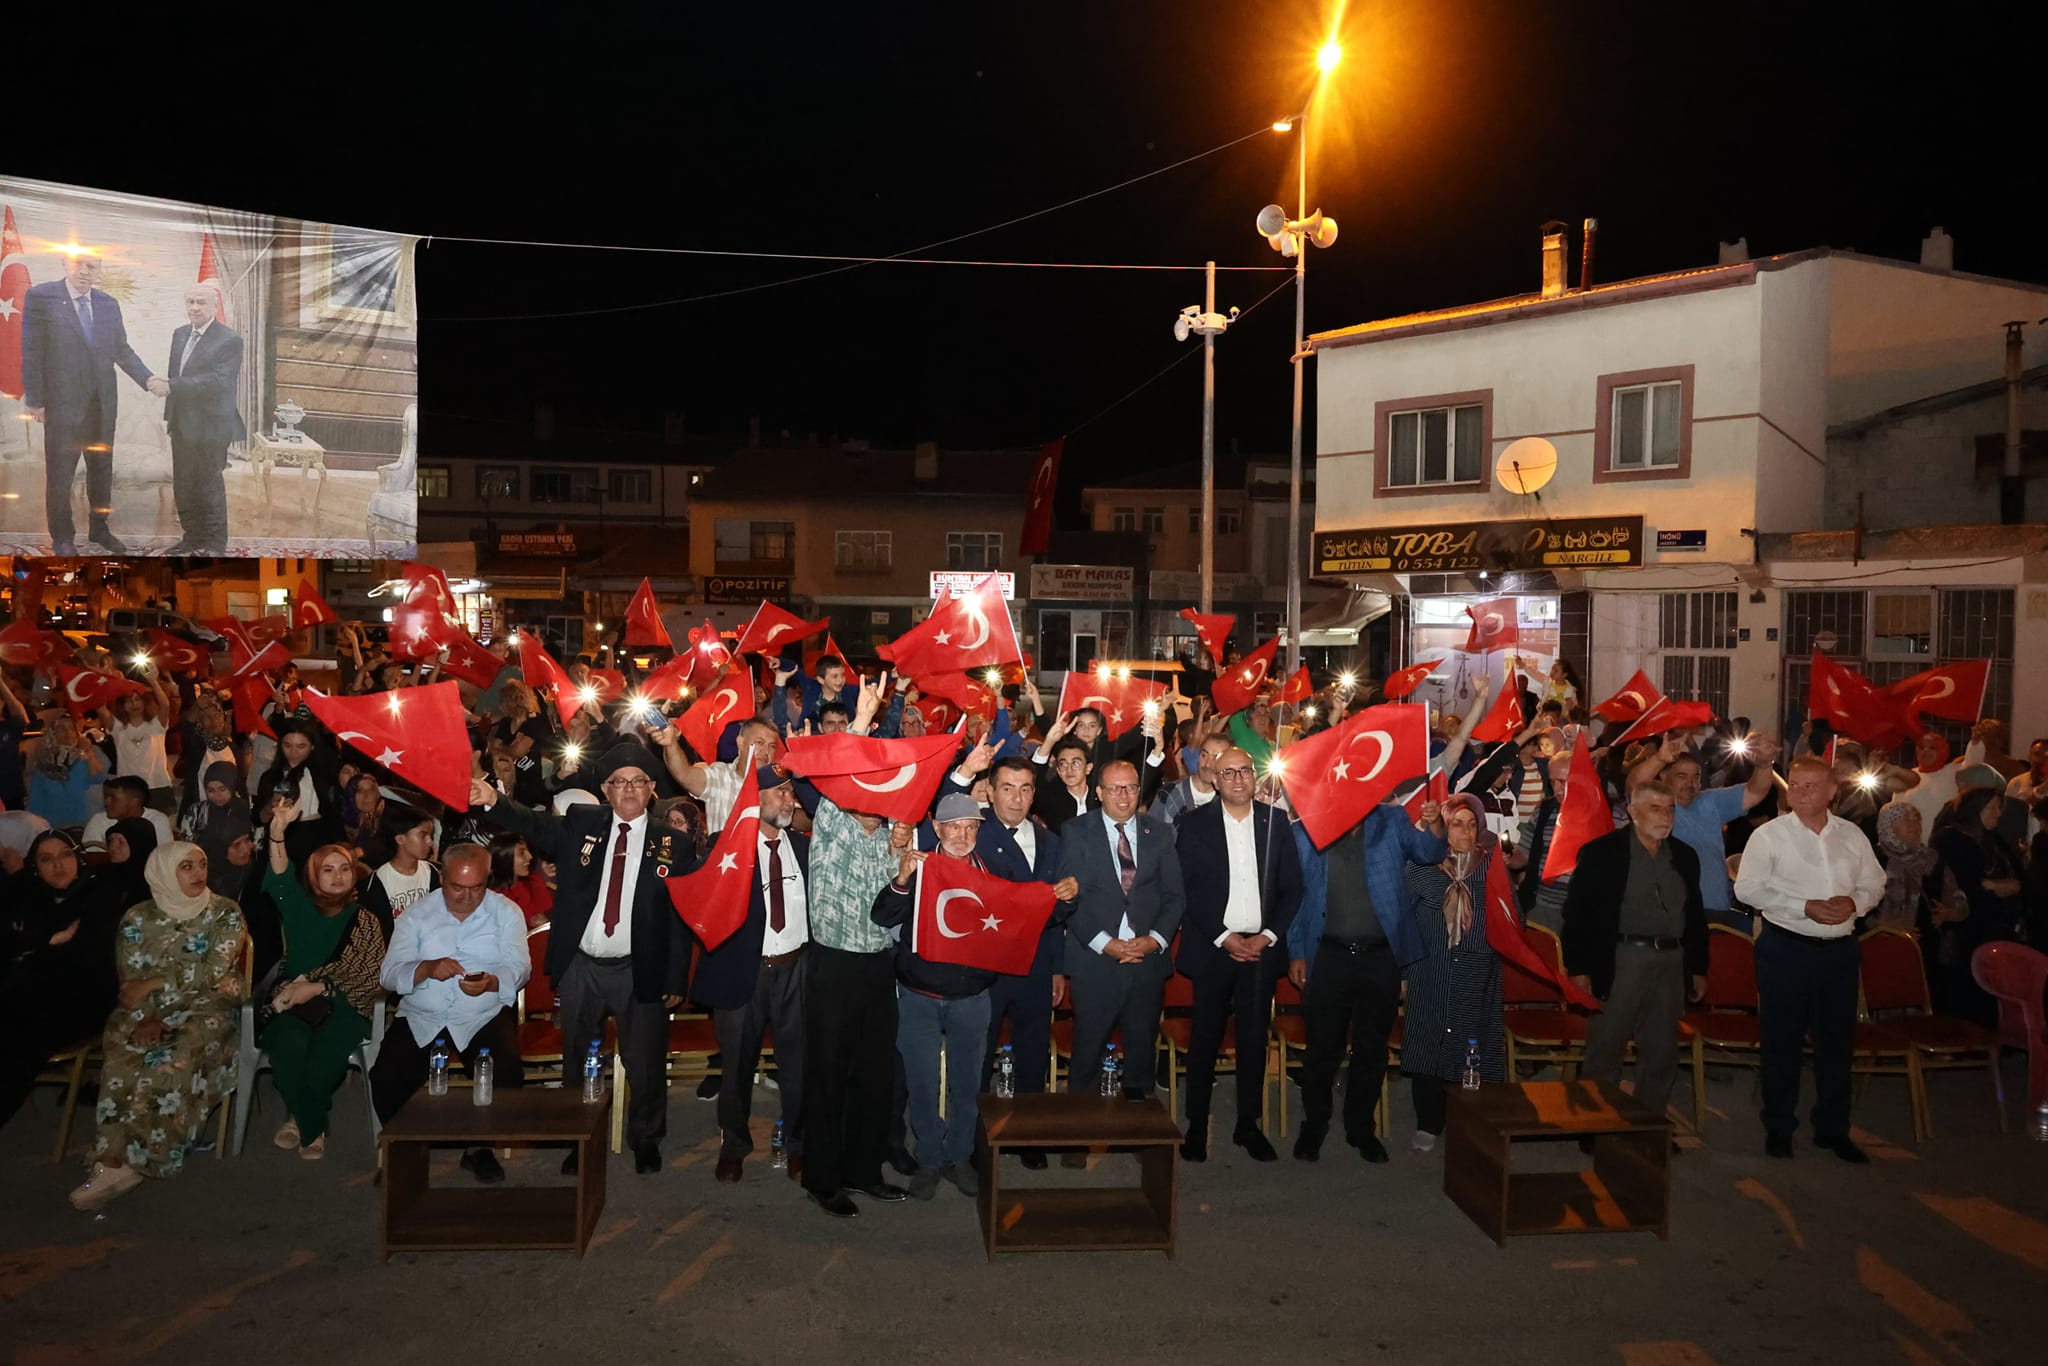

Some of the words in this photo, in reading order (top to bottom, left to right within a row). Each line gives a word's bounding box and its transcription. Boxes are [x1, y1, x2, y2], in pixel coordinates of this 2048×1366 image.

[1390, 527, 1546, 557] TOBAO
[1558, 552, 1615, 563] NARGİLE
[1397, 559, 1408, 570] 0
[1412, 558, 1443, 569] 554
[1055, 568, 1081, 579] BAY
[1086, 569, 1130, 580] MAKAS
